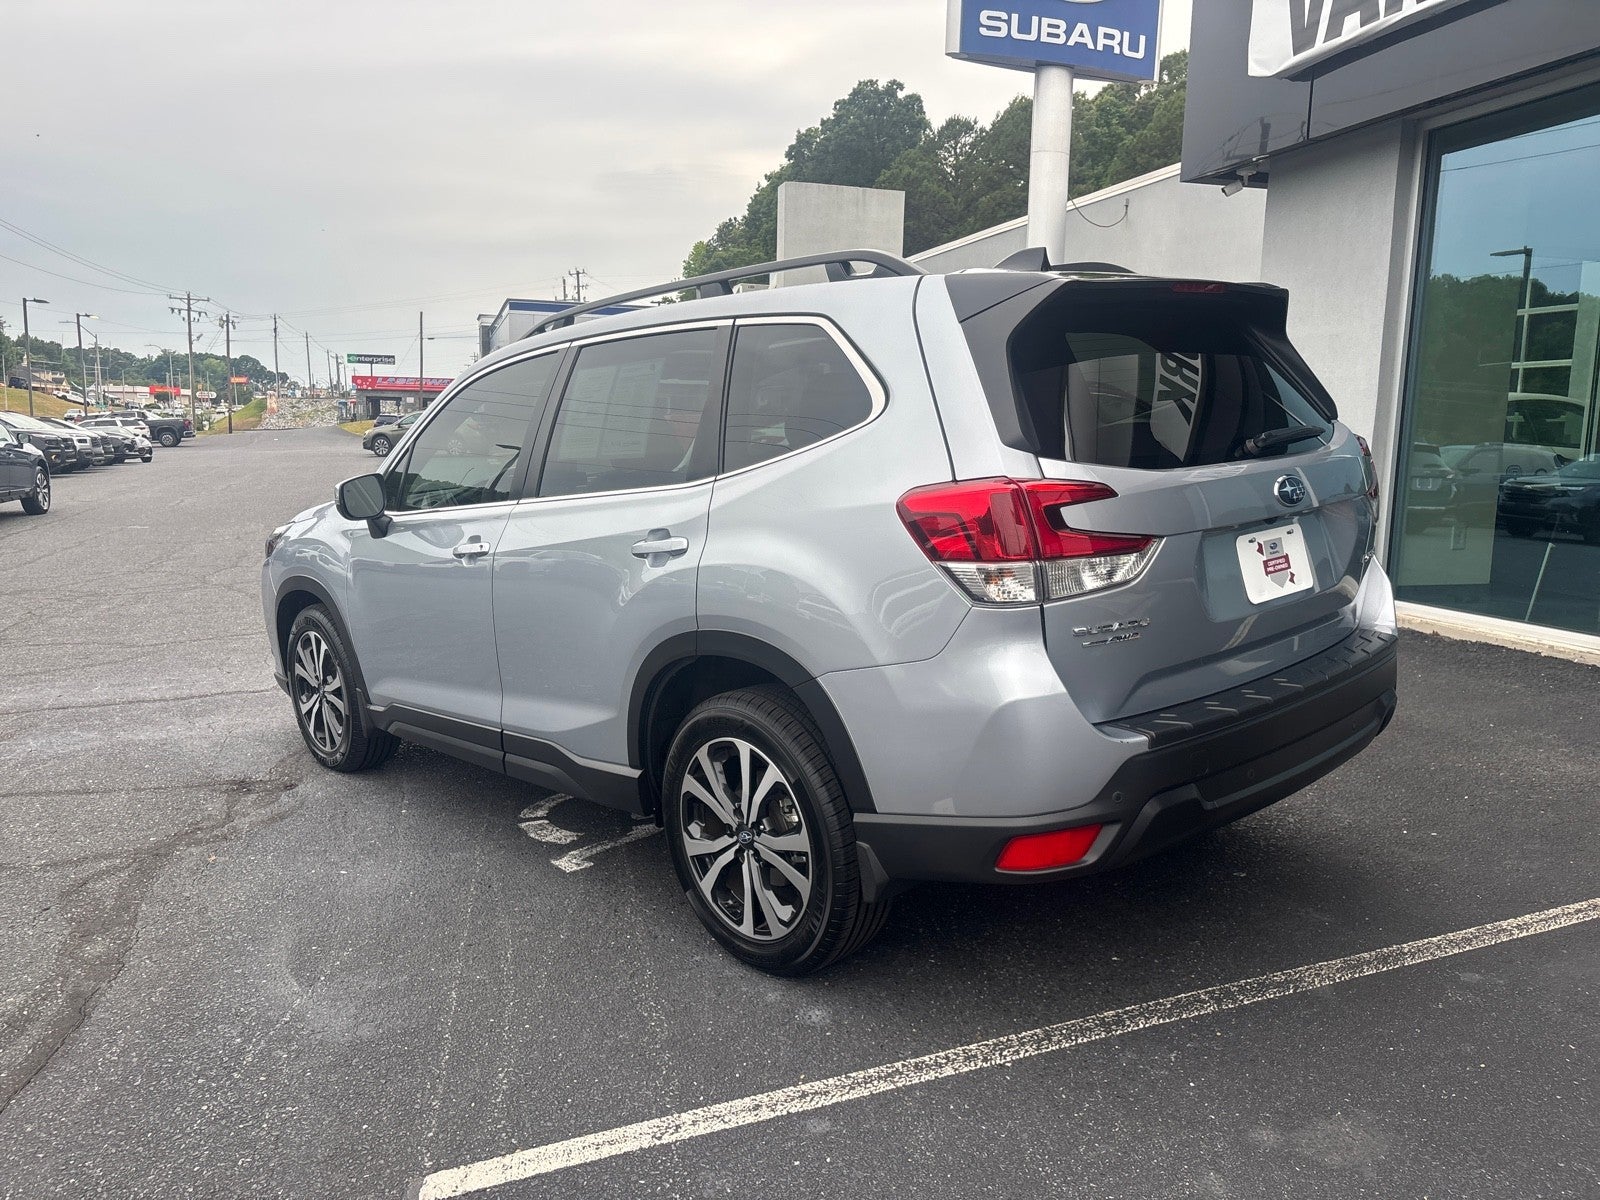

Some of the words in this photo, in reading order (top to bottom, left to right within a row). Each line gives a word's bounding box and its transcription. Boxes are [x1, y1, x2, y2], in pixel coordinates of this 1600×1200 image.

[978, 9, 1146, 60] SUBARU
[349, 355, 394, 364] enterprise
[1072, 617, 1150, 637] SUBARU
